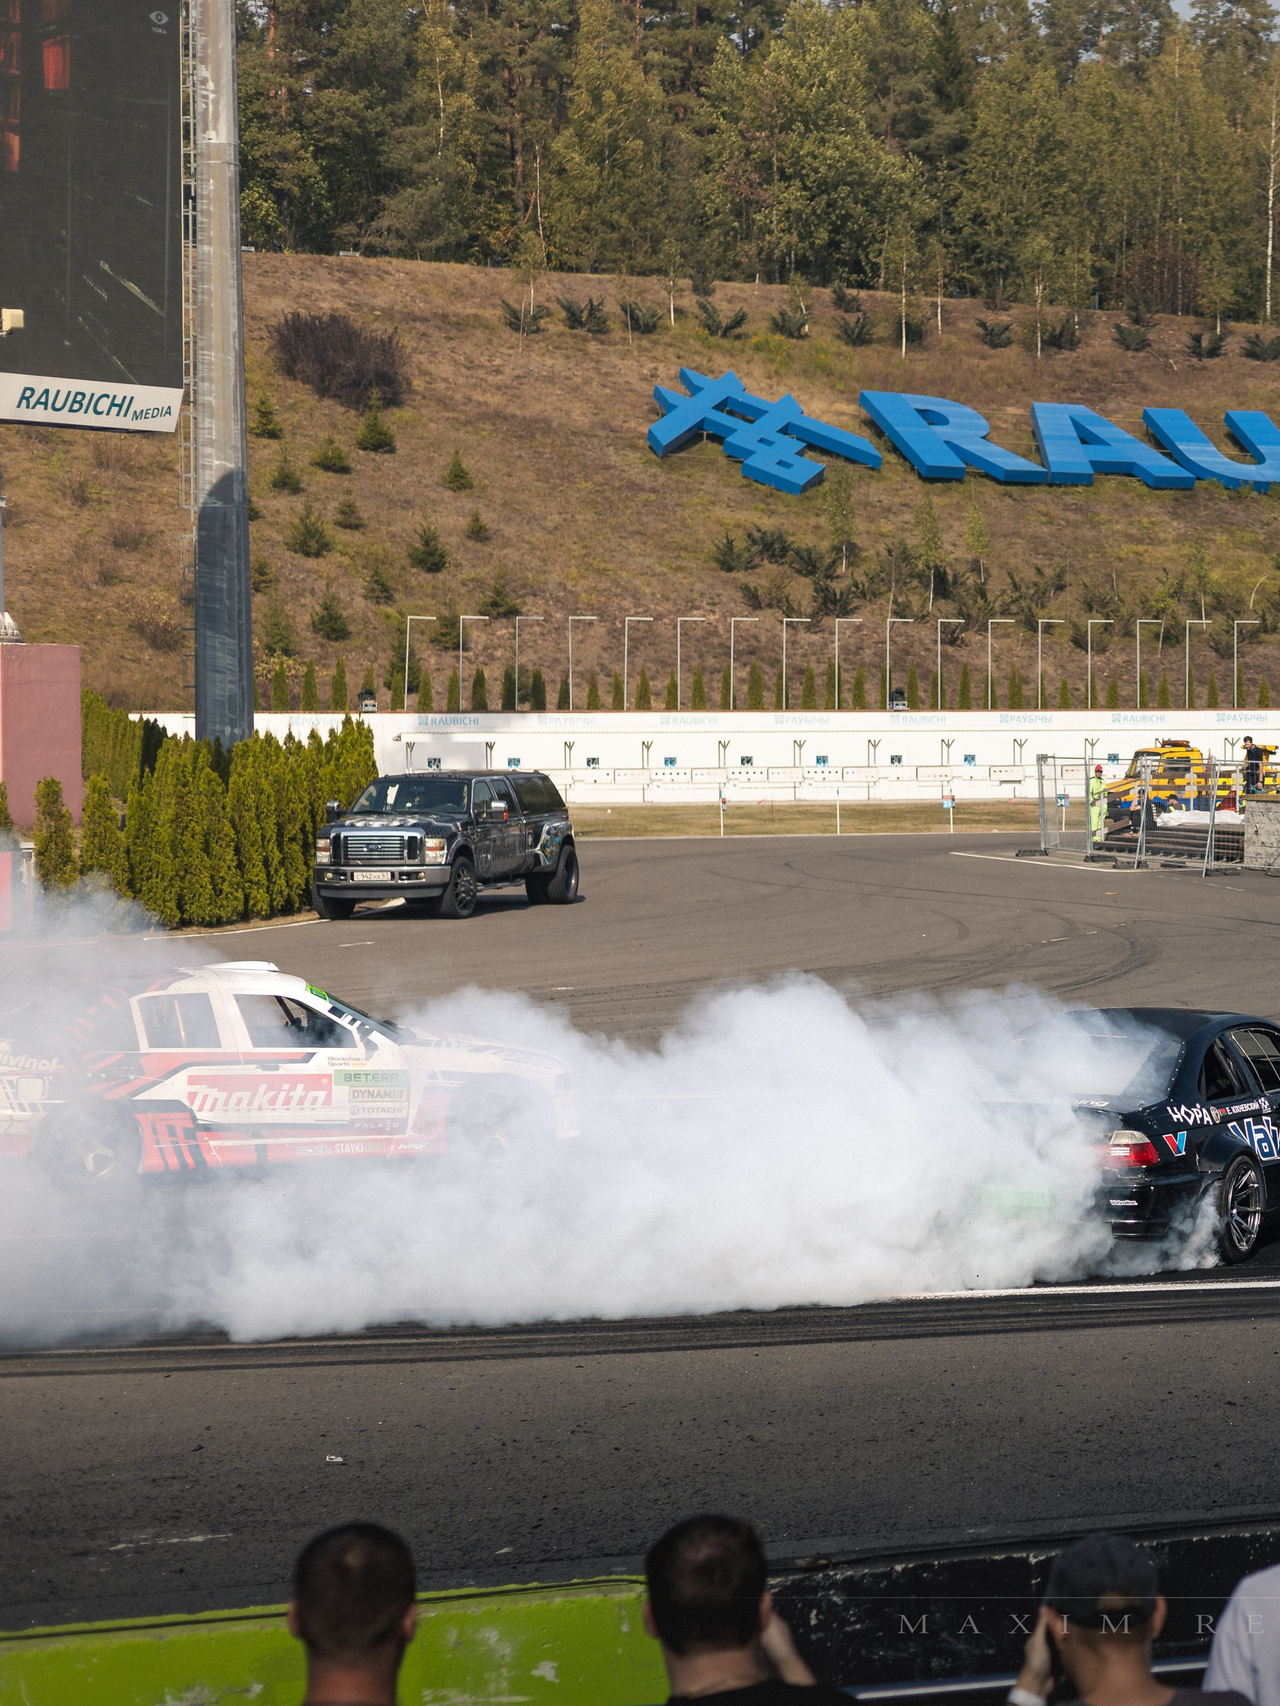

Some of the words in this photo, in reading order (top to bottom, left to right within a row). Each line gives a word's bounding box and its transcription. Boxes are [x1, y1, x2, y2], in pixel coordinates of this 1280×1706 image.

[16, 386, 135, 418] RAUBICHI
[131, 405, 172, 421] MEDIA
[430, 716, 479, 726] RAUBICHI
[672, 716, 719, 725] RAUBICHI
[901, 715, 947, 724] RAUBICHI
[1123, 714, 1166, 723] RAUBICHI
[0, 1051, 59, 1071] ivinol
[187, 1083, 328, 1112] makita
[361, 1106, 403, 1114] TOTACHI
